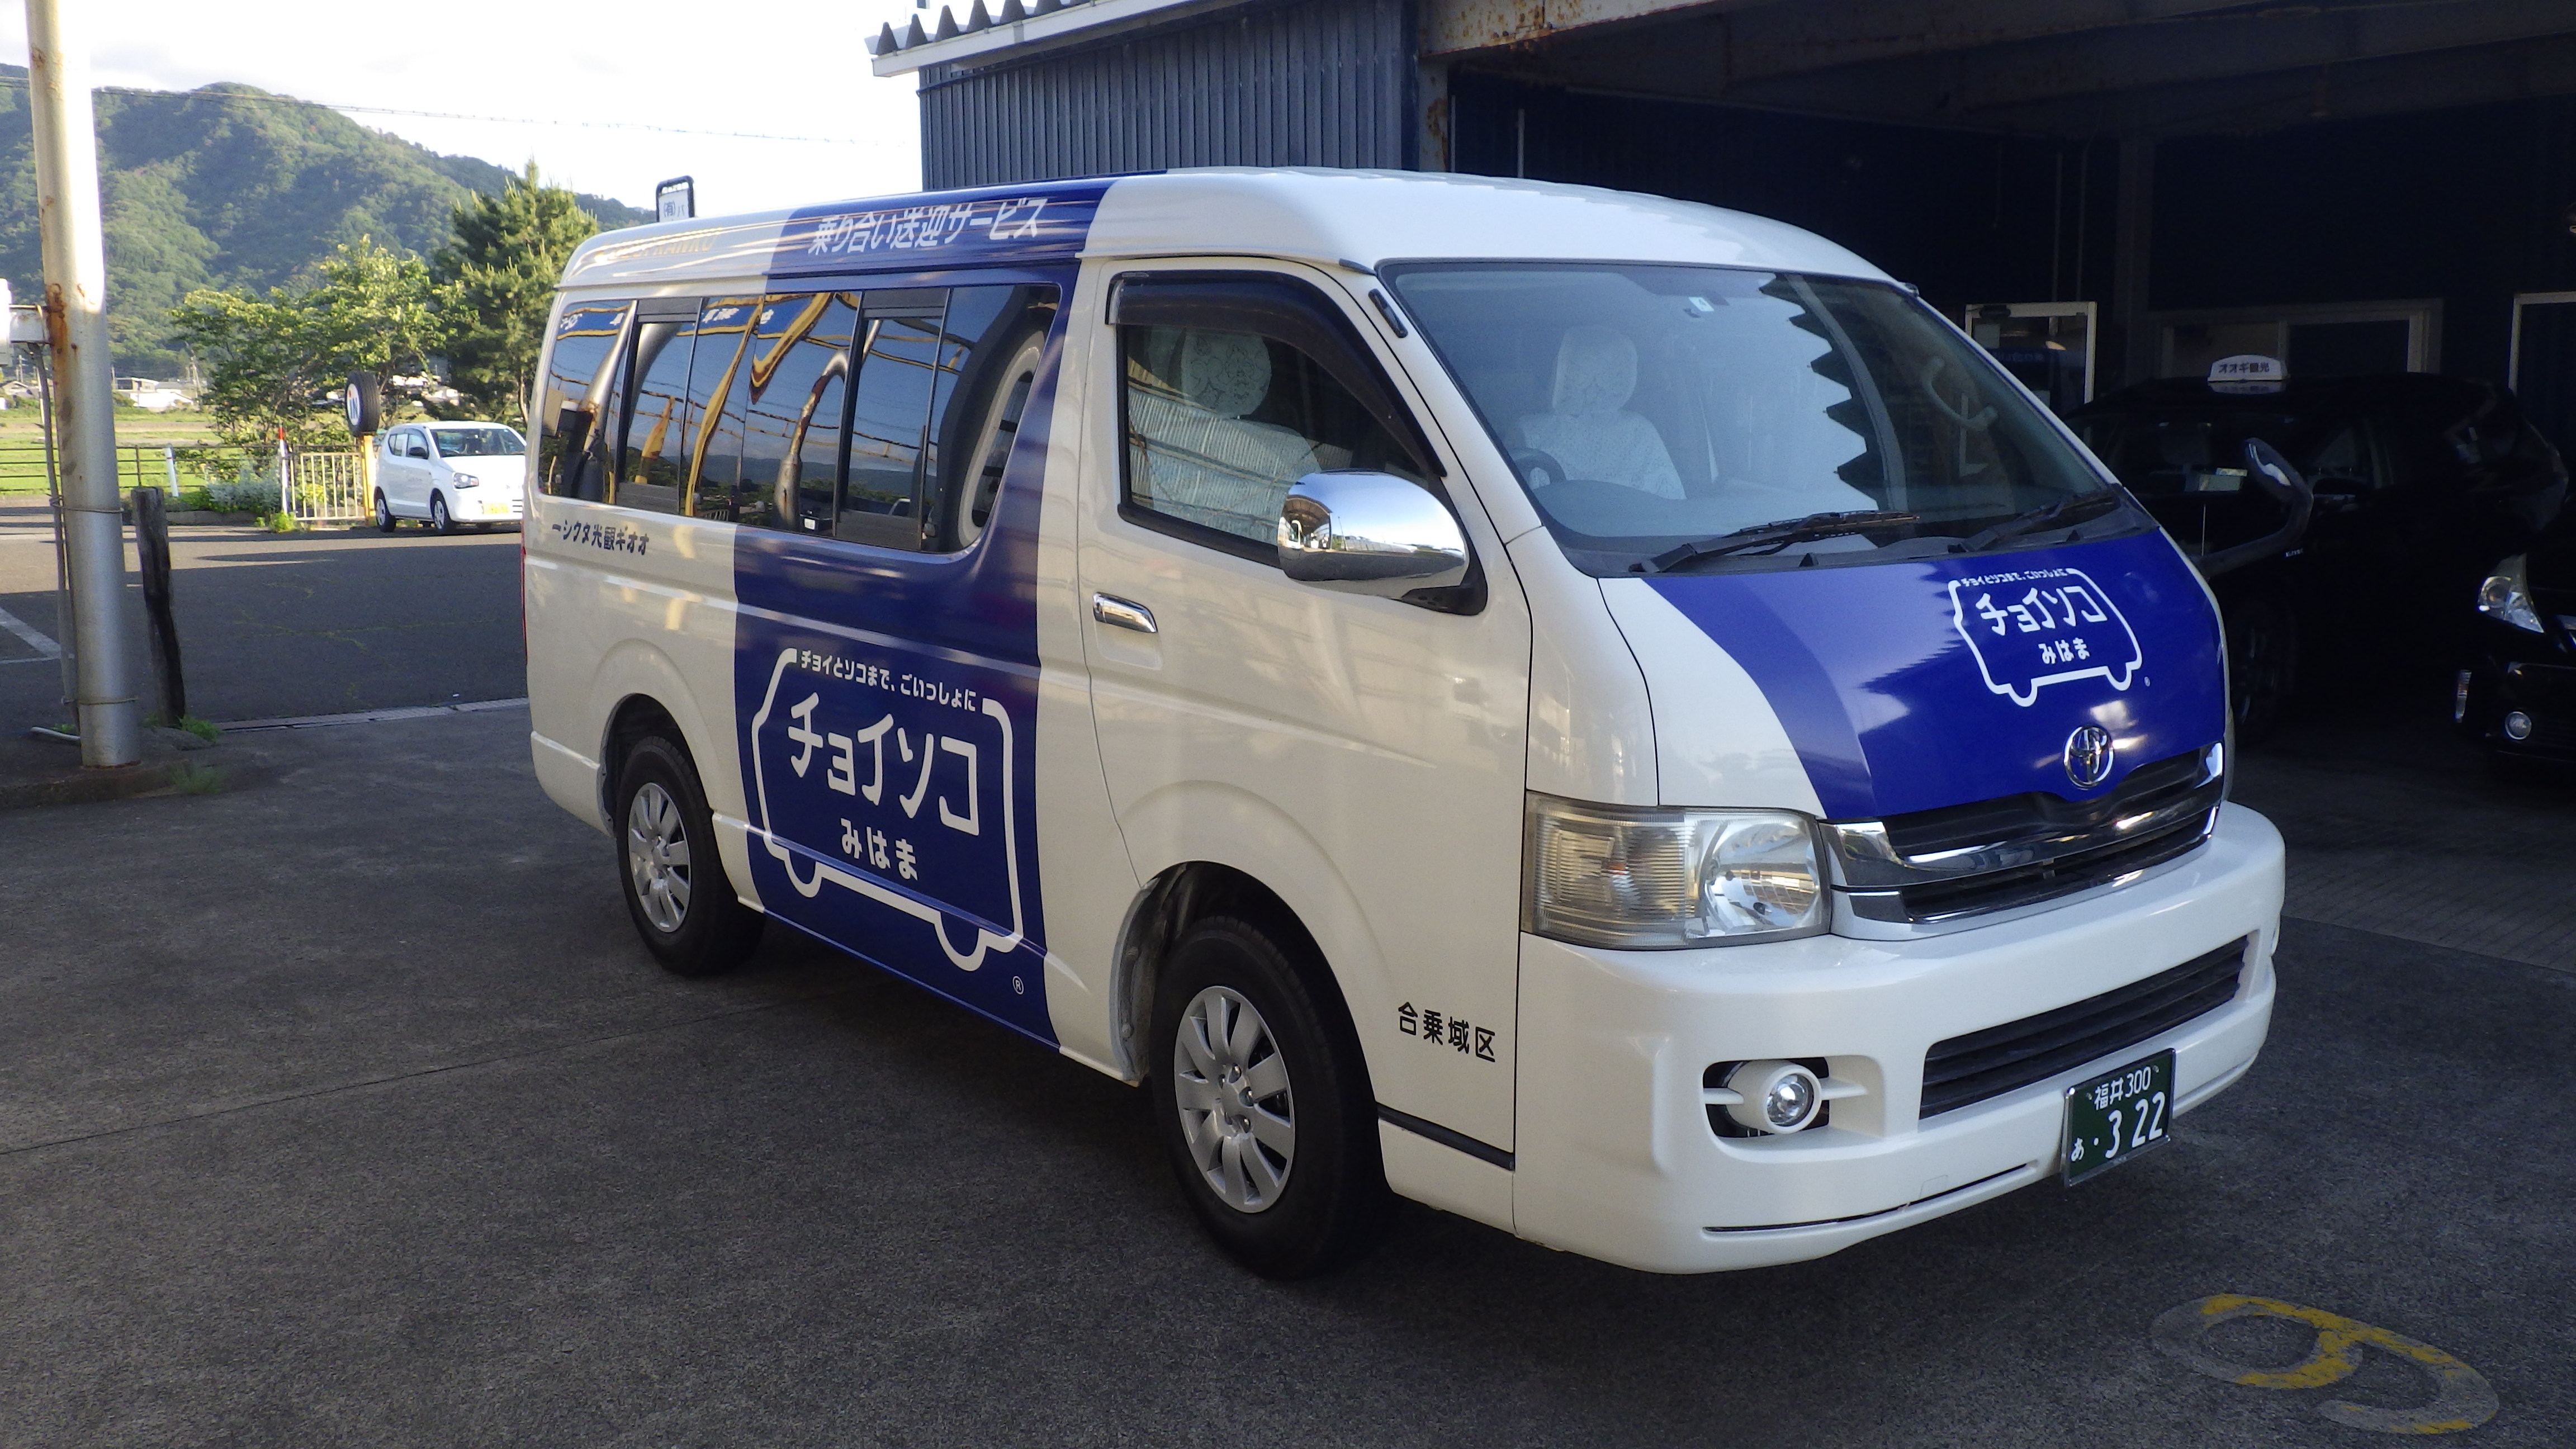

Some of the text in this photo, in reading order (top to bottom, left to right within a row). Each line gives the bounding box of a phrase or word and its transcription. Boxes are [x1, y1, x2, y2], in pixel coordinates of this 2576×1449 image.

[808, 197, 1048, 255] 乗り合い送迎サービス
[1975, 587, 2108, 636] チョイソコ
[2038, 637, 2090, 664] みはま
[801, 650, 977, 712] チョイとソコまで、ごいっしょに
[788, 692, 979, 836] チョイソコ
[840, 818, 917, 881] みはま
